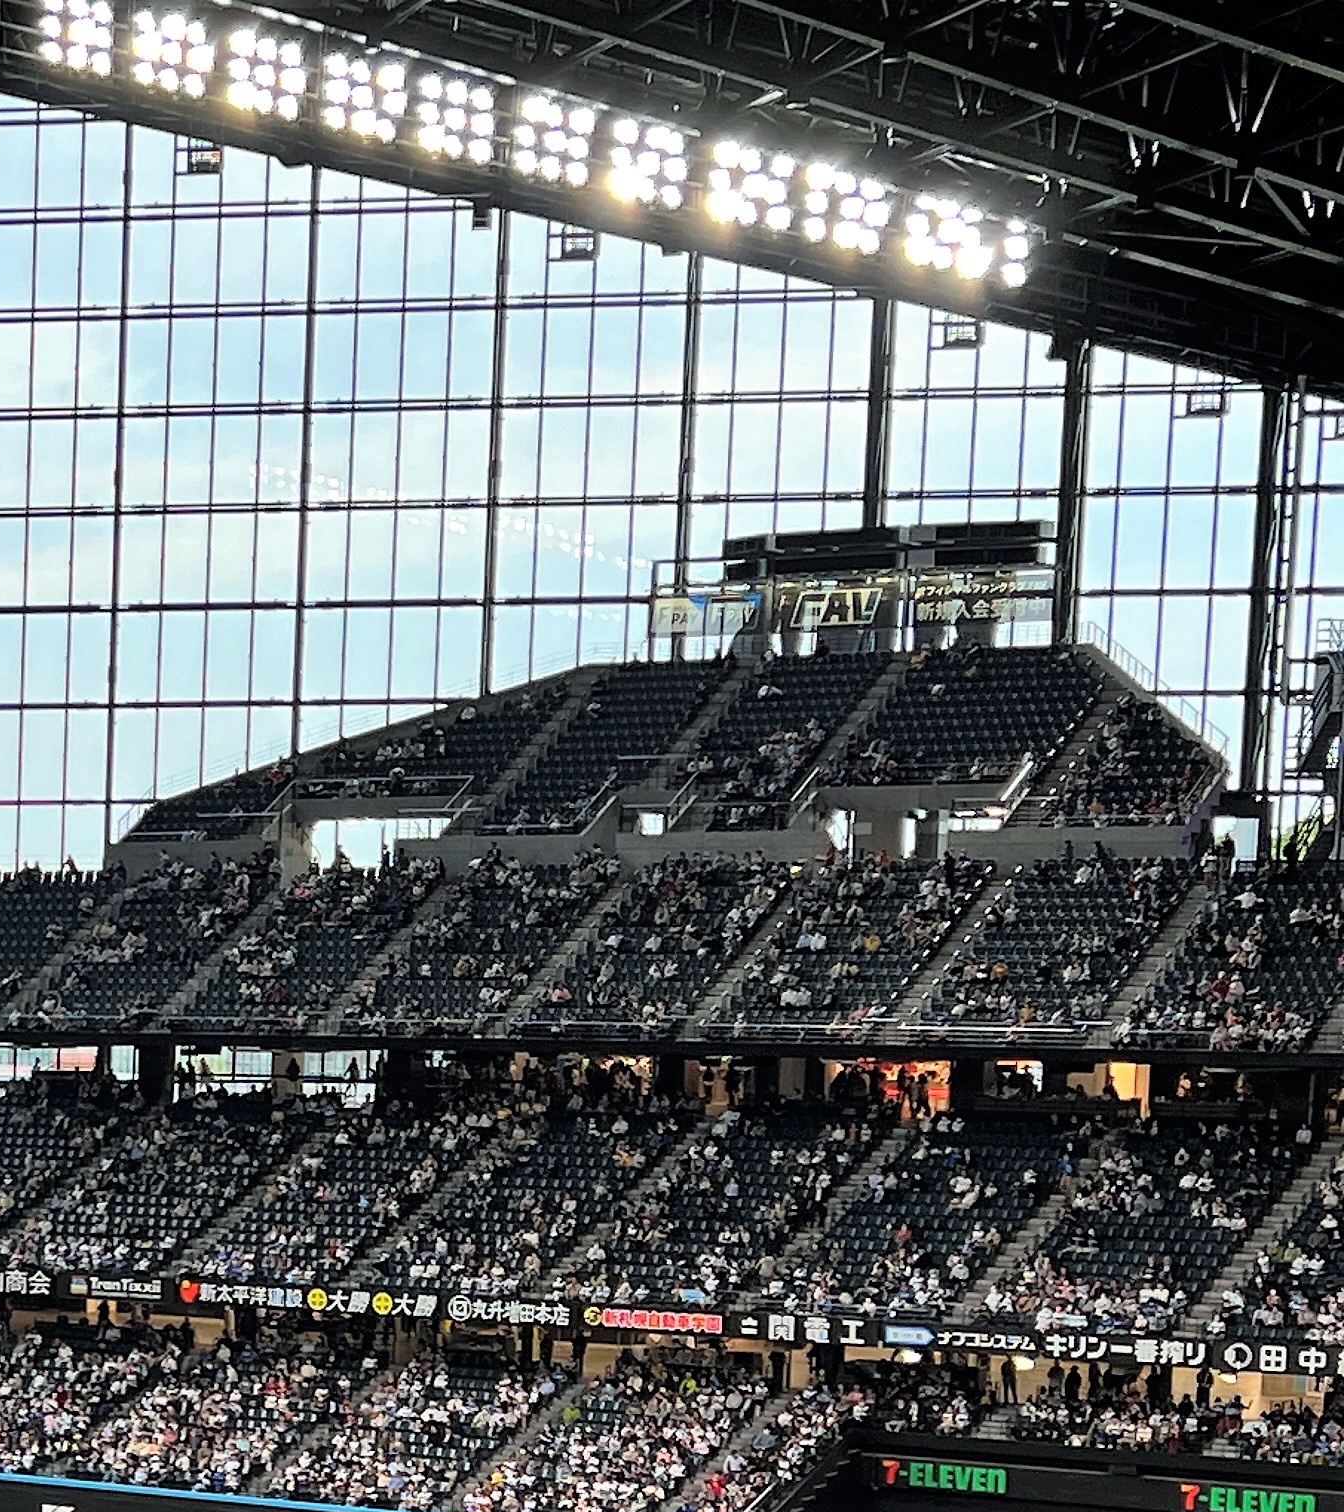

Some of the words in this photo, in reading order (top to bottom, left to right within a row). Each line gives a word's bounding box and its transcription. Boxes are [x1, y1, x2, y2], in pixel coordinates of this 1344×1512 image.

[1045, 1334, 1206, 1366] キリン一番搾り
[1259, 1344, 1344, 1377] 田中
